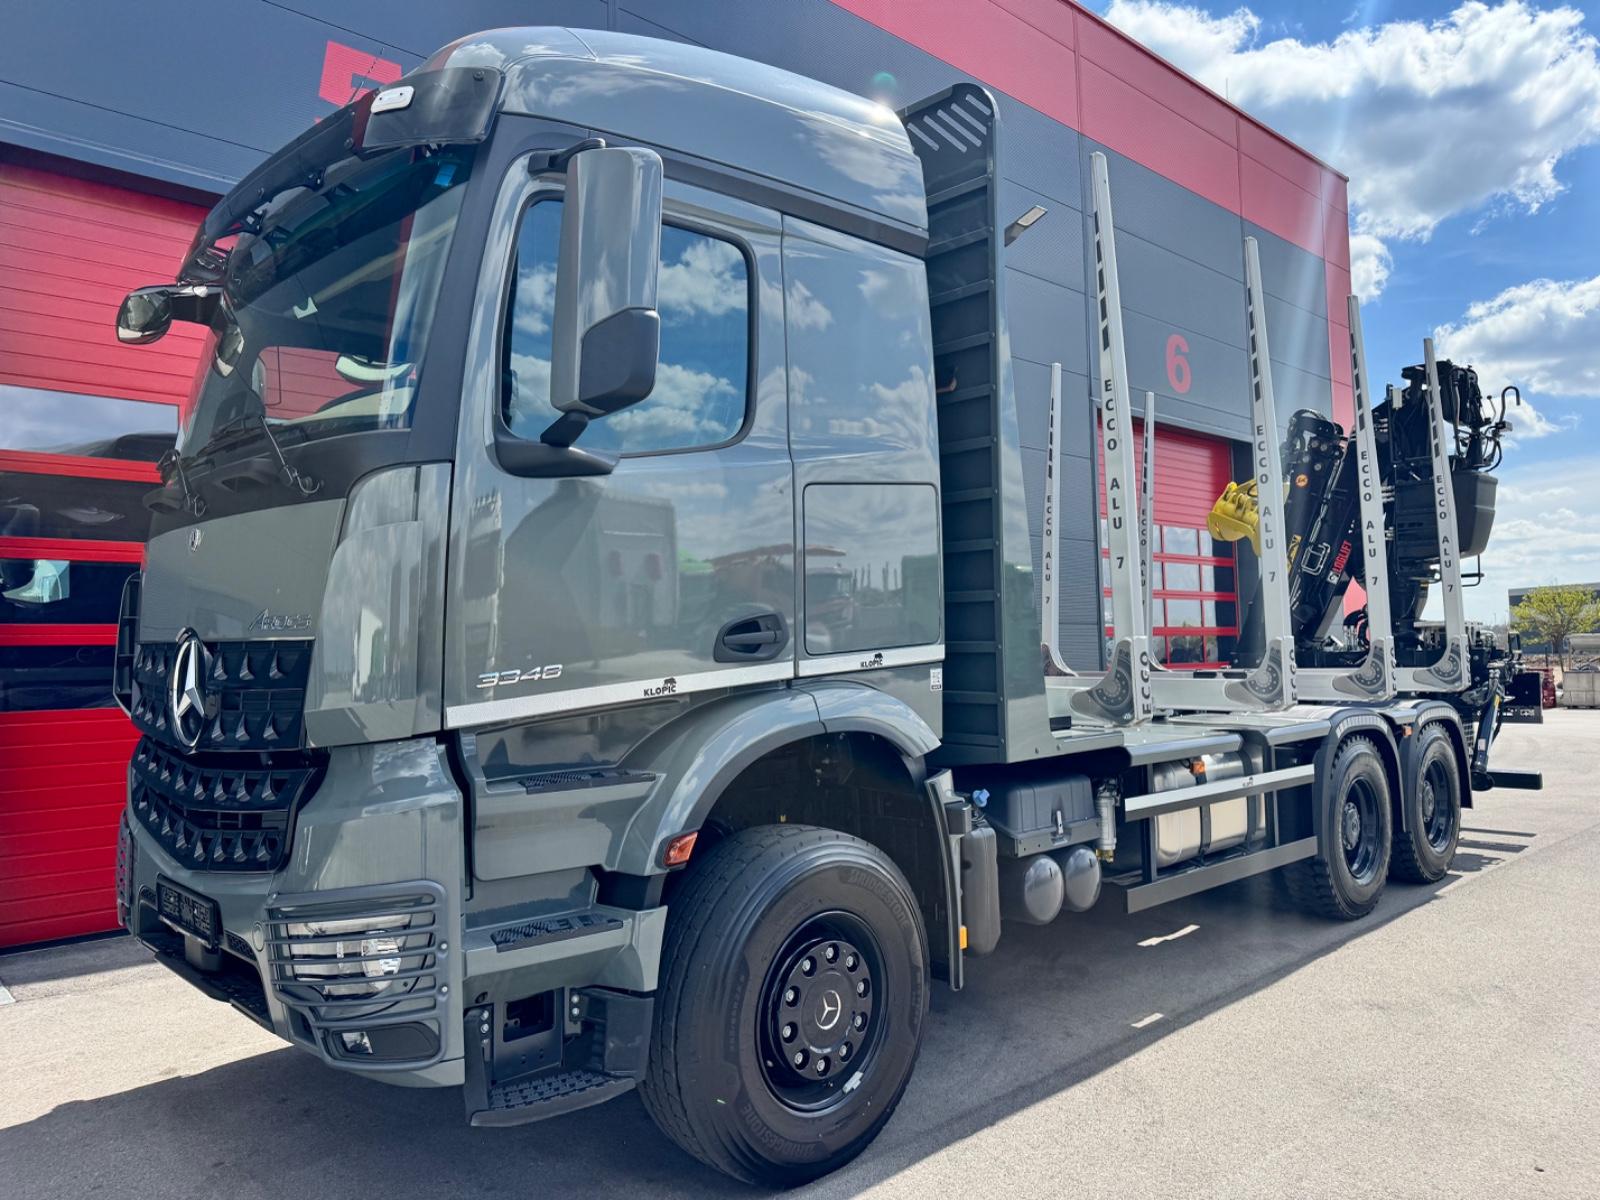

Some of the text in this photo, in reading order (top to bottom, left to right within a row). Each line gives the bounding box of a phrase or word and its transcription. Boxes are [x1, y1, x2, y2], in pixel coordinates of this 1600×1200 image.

[1166, 334, 1192, 393] 6
[1104, 379, 1125, 569] ECCO ALU 7
[1256, 425, 1276, 583] ECCO ALU 7
[1361, 451, 1378, 586] ECCO ALU 7
[1436, 475, 1454, 593] ECCO ALU 7
[1045, 596, 1050, 604] 7
[476, 664, 563, 688] 3348
